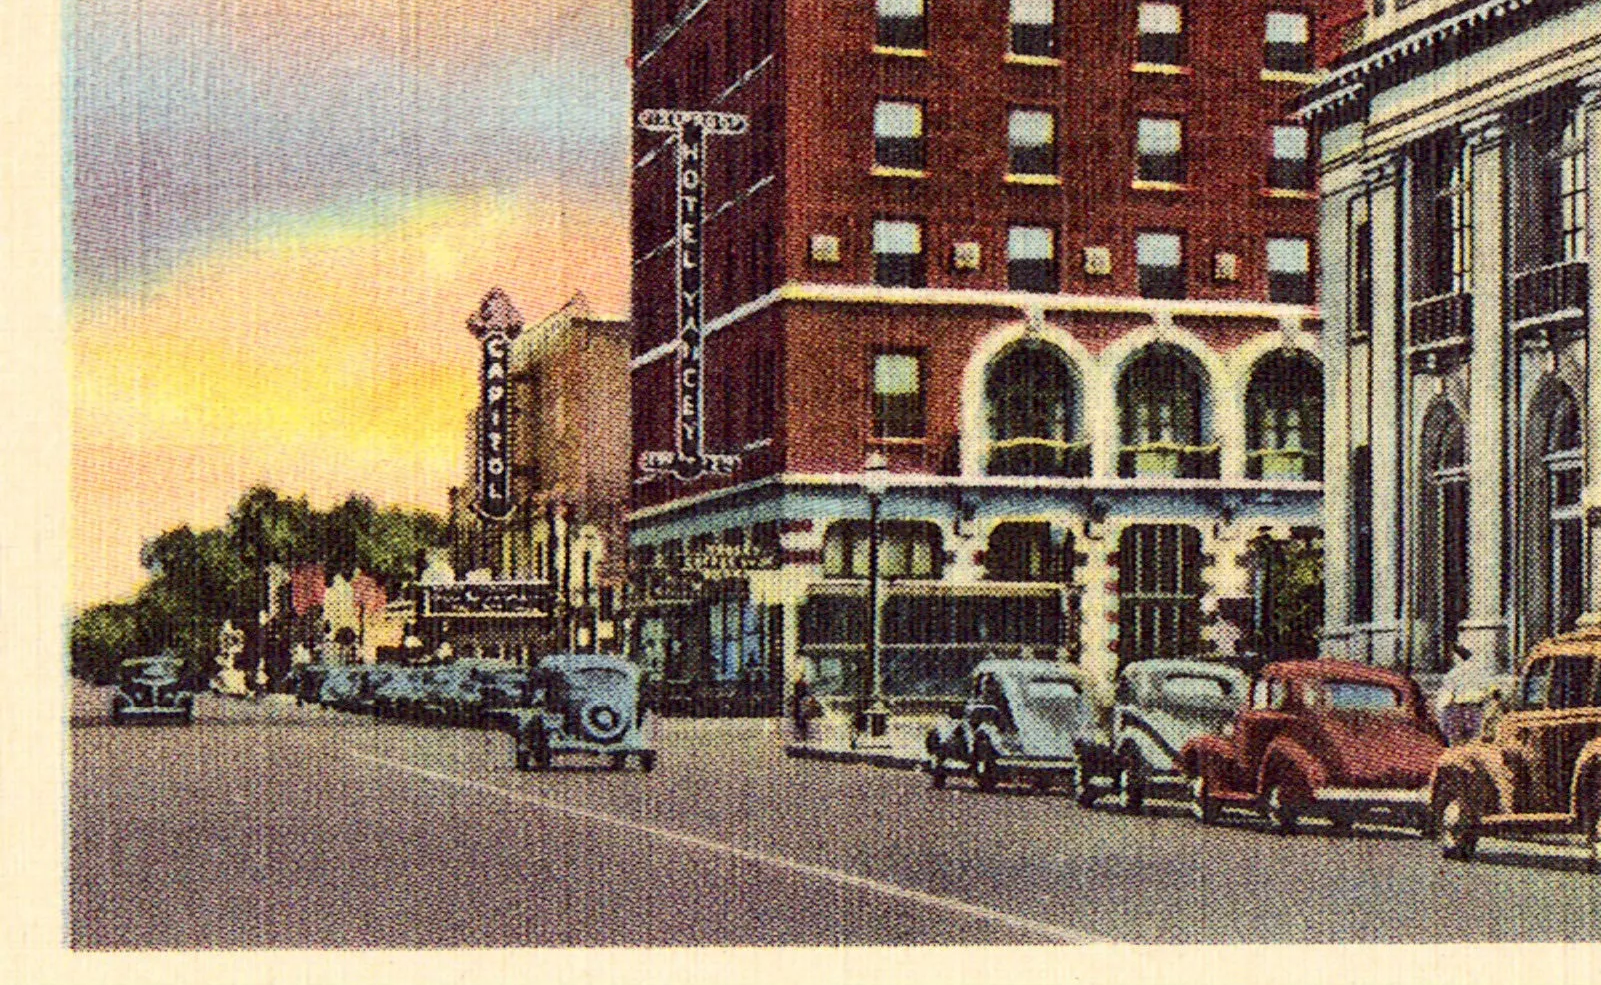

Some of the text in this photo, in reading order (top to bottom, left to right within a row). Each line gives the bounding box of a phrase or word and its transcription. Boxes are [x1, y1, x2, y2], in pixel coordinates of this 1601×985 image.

[682, 142, 699, 441] HOTEL YANCEY
[486, 337, 505, 500] CAPITOL
